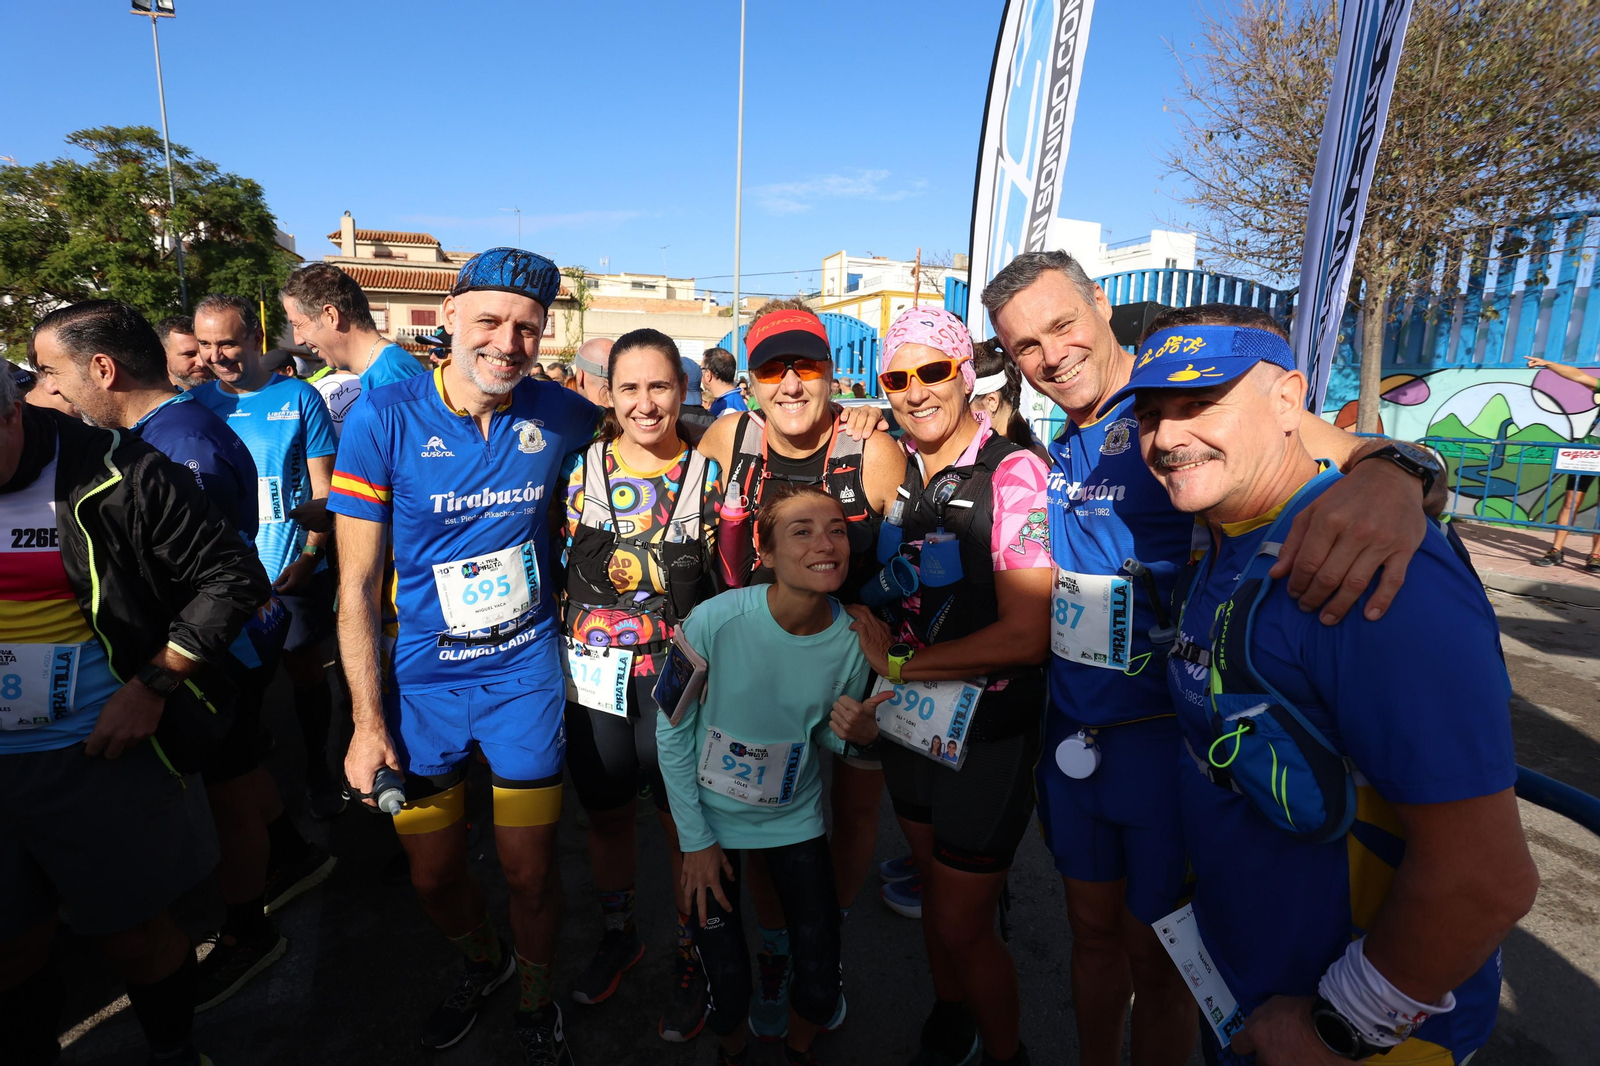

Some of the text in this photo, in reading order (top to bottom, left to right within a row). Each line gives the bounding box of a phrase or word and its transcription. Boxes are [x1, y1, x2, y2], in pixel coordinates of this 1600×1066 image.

[421, 450, 455, 458] austral
[273, 480, 283, 520] PIRATILLA
[430, 481, 545, 513] Tirabuzón
[1095, 508, 1110, 516] 1982
[462, 574, 511, 606] 695
[524, 547, 539, 604] PIRATILLA
[475, 606, 493, 614] MIGUEL
[1113, 585, 1127, 664] PIRATILLA
[1219, 599, 1235, 671] AONIJIE
[1, 673, 23, 700] 8
[53, 651, 72, 720] PIRATILLA
[615, 656, 628, 711] PIRATILLA
[1184, 689, 1204, 708] 1982
[888, 683, 935, 721] 590
[722, 754, 766, 785] 921
[782, 745, 803, 800] PIRATILLA
[1198, 951, 1212, 974] FRANCIS
